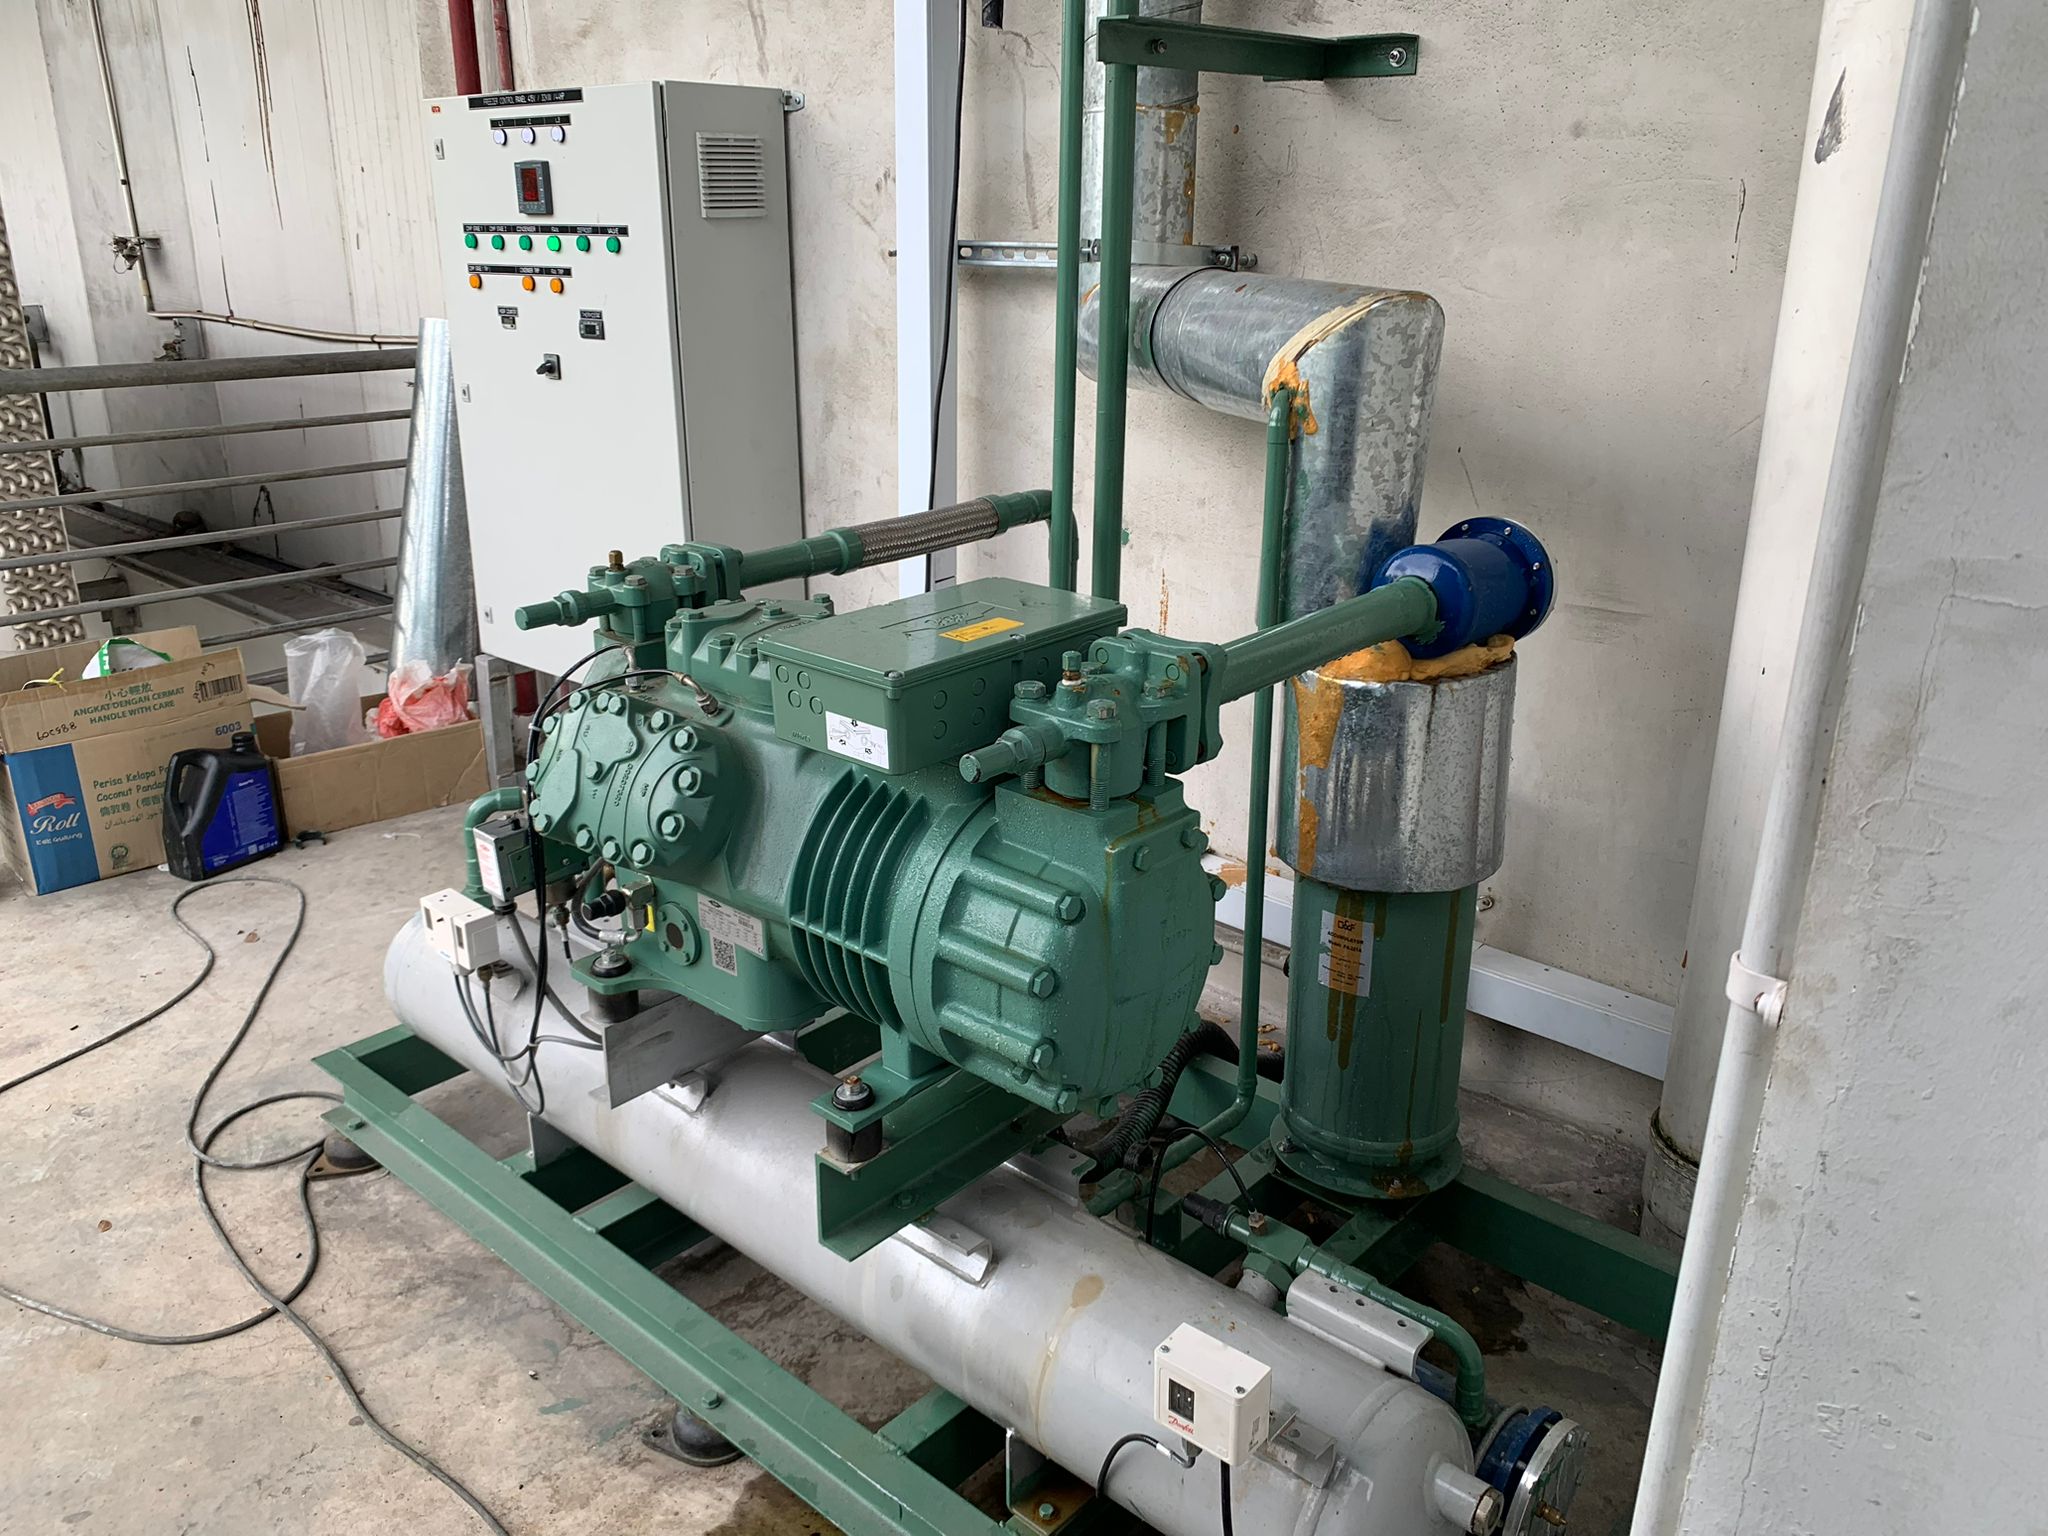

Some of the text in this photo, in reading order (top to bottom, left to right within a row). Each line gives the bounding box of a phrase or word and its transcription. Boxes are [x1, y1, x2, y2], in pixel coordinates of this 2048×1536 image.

[73, 703, 111, 717] ANGKAT
[111, 695, 150, 711] DENGAN
[151, 686, 185, 702] CERMAT
[89, 699, 176, 725] HANDLE WITH CARE
[214, 721, 242, 737] 6003
[93, 776, 123, 790] Perisa
[126, 769, 156, 784] Kelapa
[96, 786, 133, 802] Coconut
[30, 812, 81, 835] Roll
[1168, 1415, 1195, 1435] Danfoss
